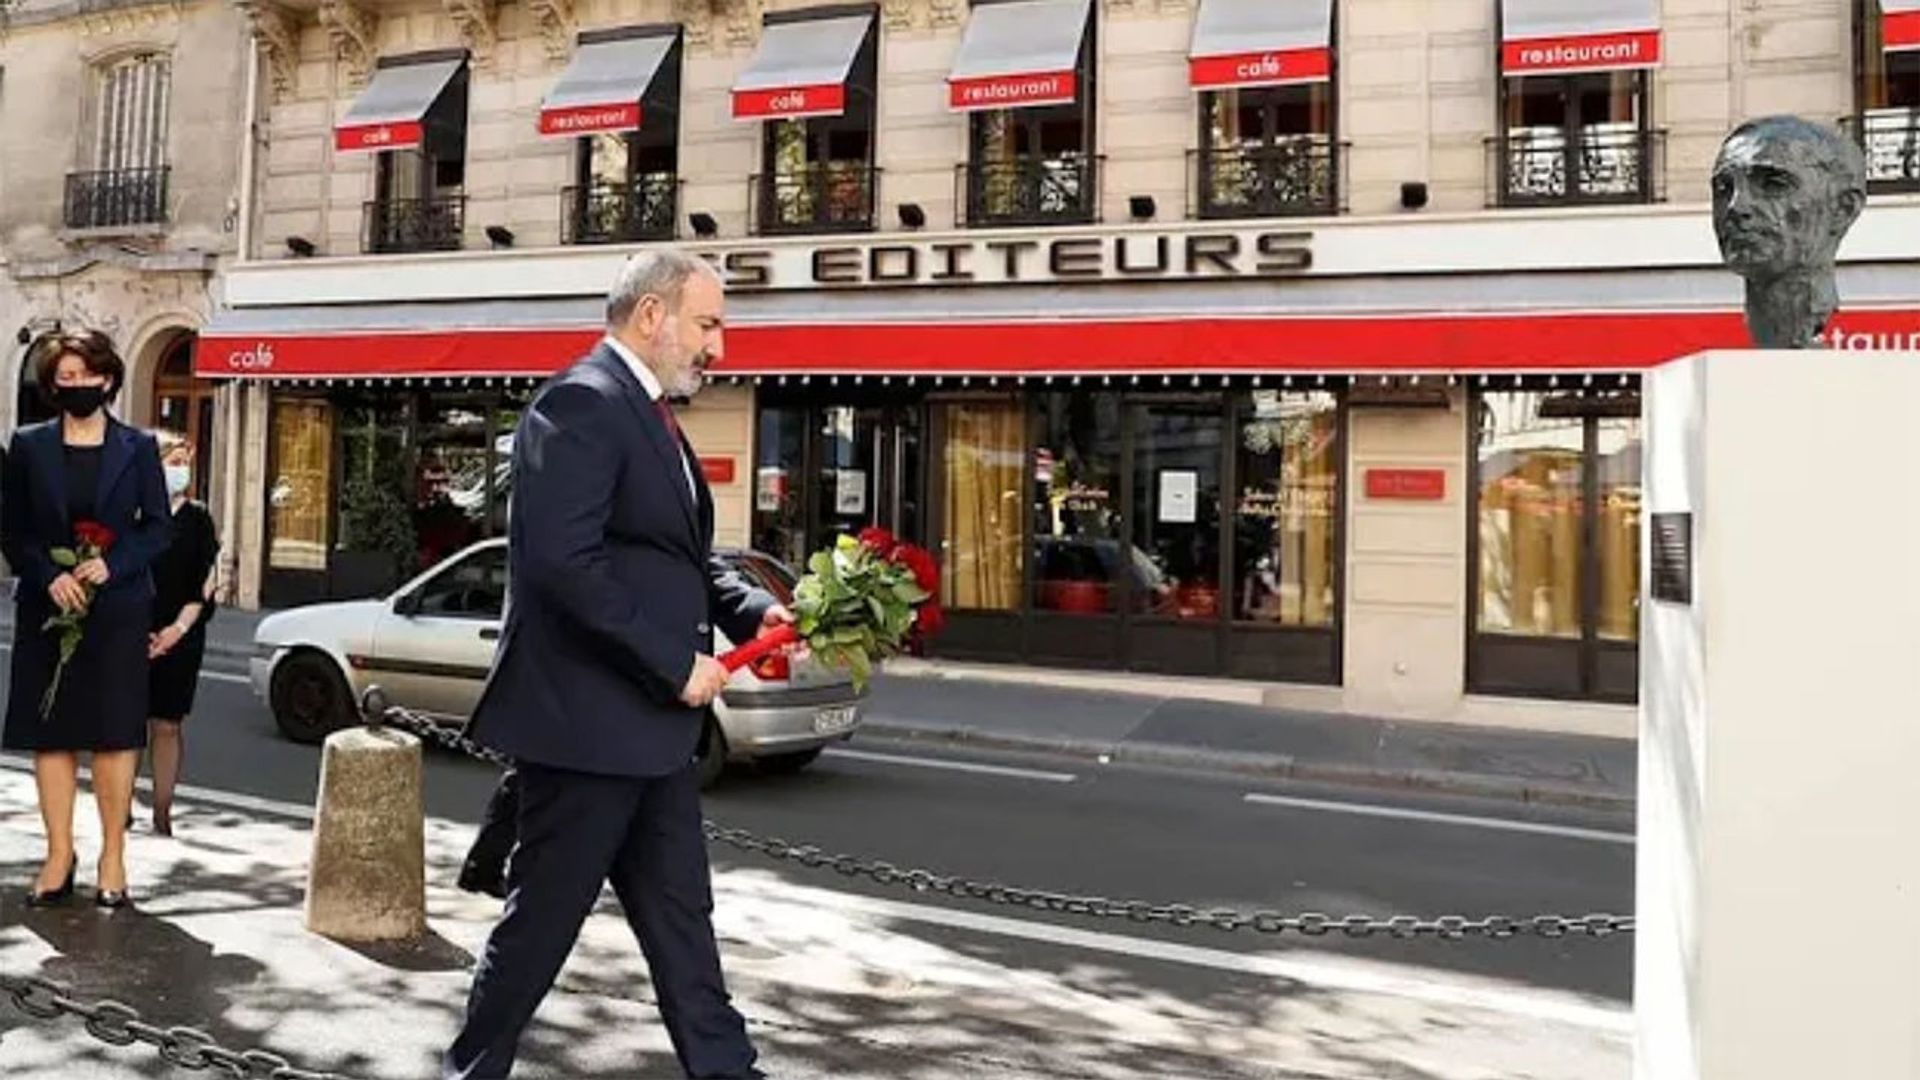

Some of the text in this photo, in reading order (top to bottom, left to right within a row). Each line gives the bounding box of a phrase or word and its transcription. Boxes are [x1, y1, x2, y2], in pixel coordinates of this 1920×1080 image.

[1521, 39, 1639, 63] restaurant
[1237, 55, 1280, 77] café
[768, 90, 805, 110] café
[963, 79, 1058, 100] restaurant
[812, 232, 1314, 282] EDITEURS
[229, 342, 275, 369] café
